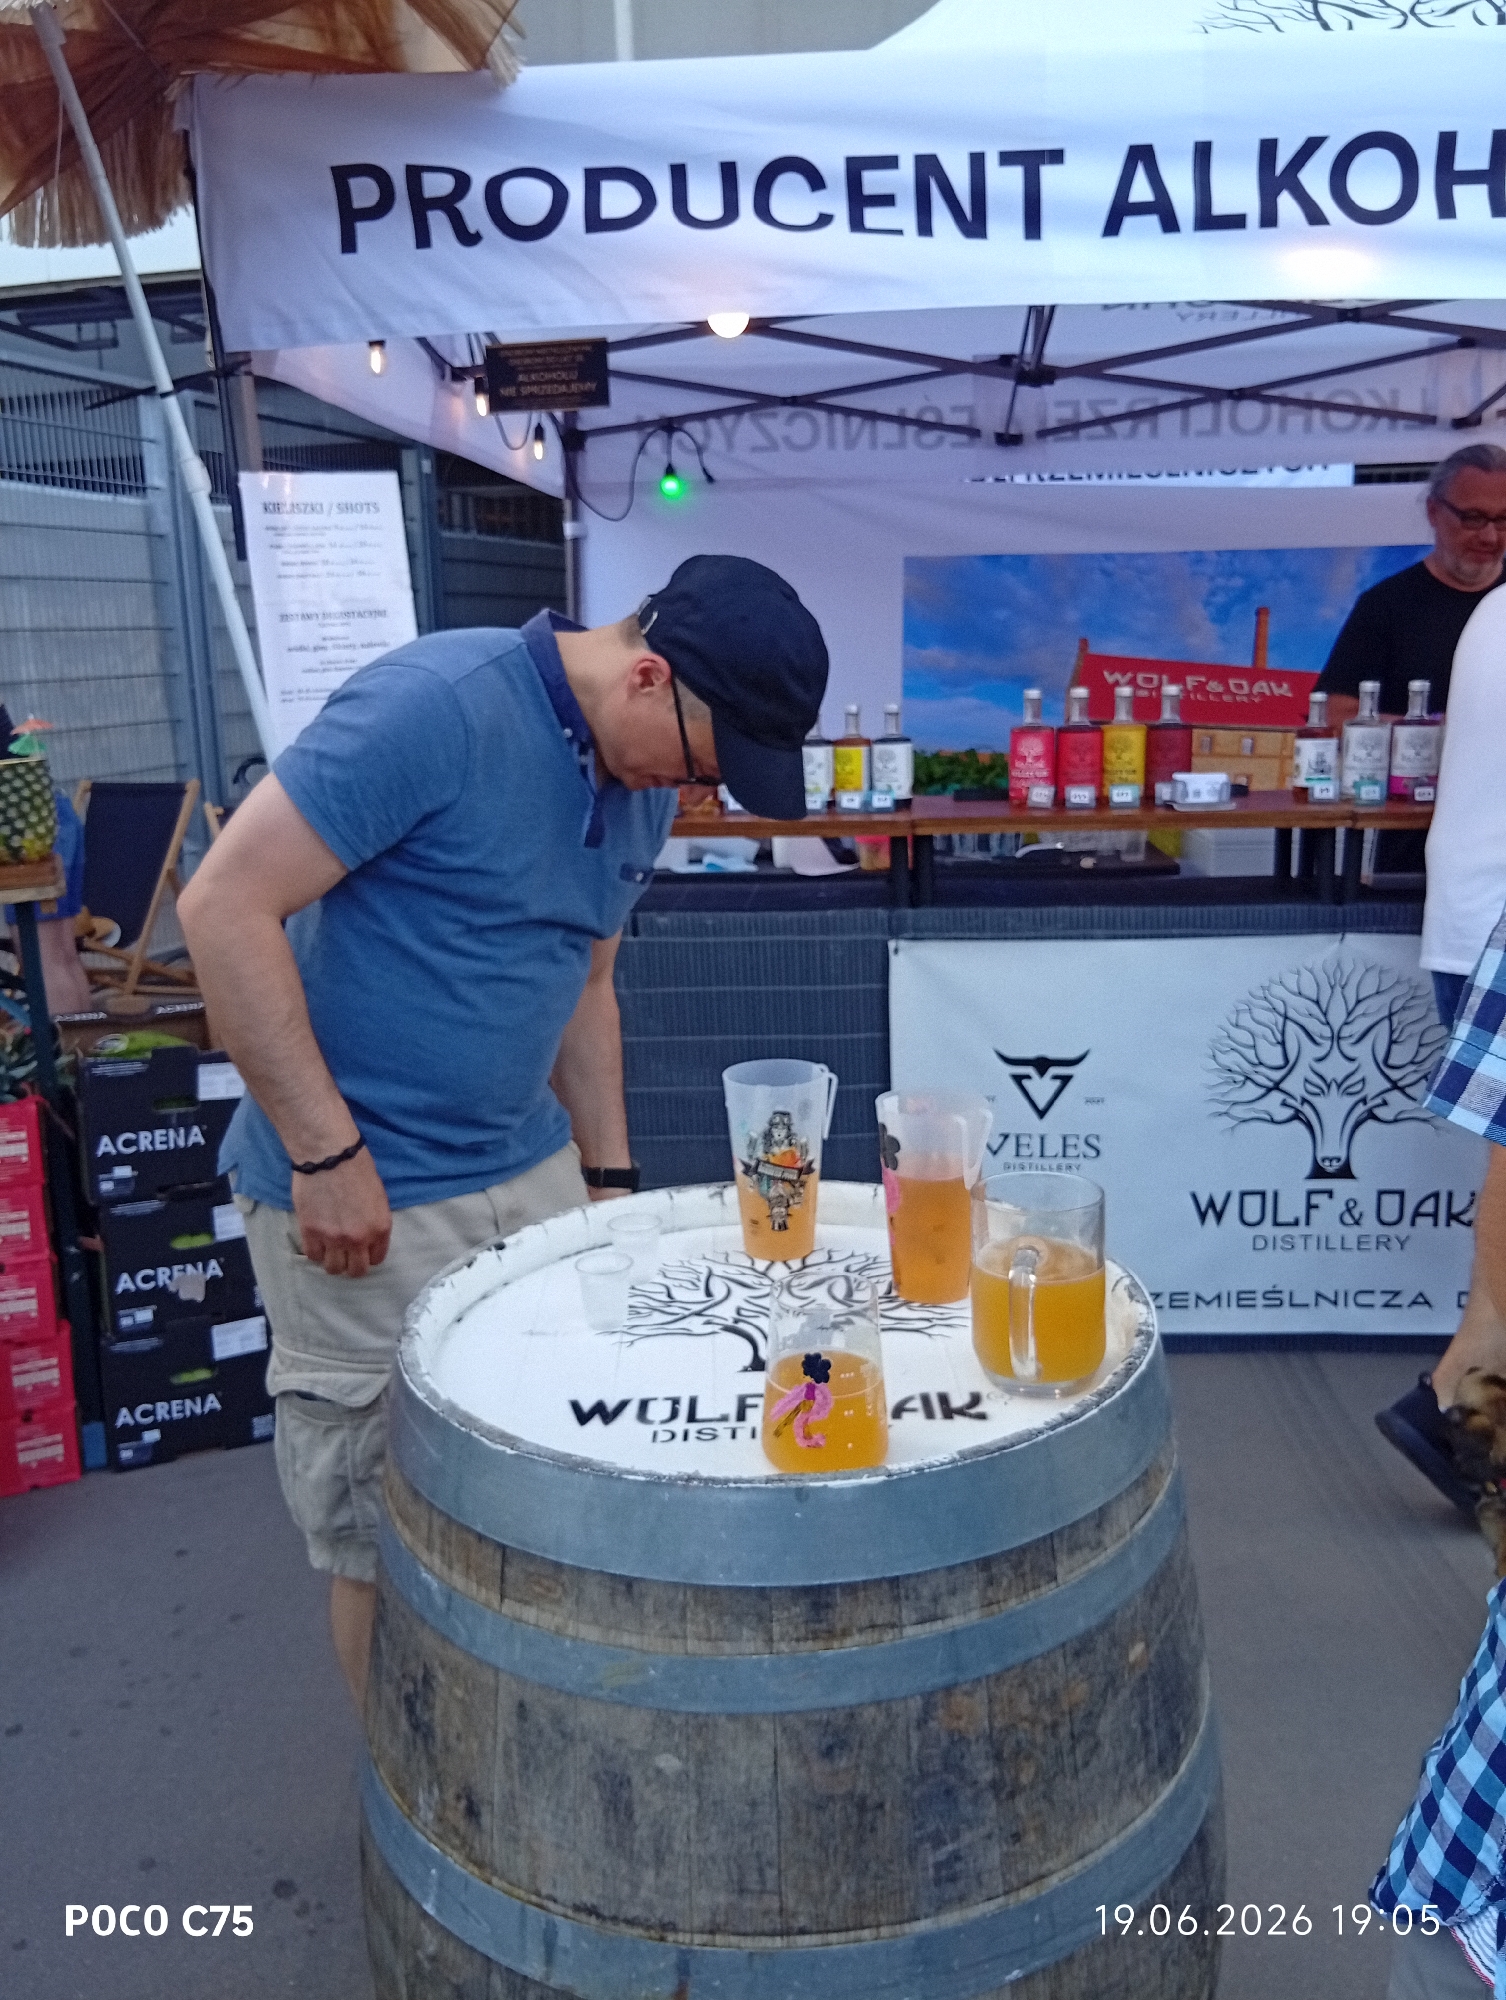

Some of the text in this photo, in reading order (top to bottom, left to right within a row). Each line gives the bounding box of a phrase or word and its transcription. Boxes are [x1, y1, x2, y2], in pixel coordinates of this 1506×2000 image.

[330, 129, 1506, 254] PRODUCENT ALKOH
[96, 1125, 206, 1157] ACRENA
[986, 1132, 1101, 1159] VELES
[1003, 1161, 1081, 1172] DISTILLERY
[1190, 1187, 1476, 1228] WOLF & OAK
[1252, 1234, 1411, 1252] DISTILLERY
[1150, 1284, 1434, 1310] ZEMIEŚLNICZA
[115, 1392, 222, 1429] ACRENA
[568, 1391, 988, 1427] WOLF AK
[652, 1426, 757, 1443] DISTI
